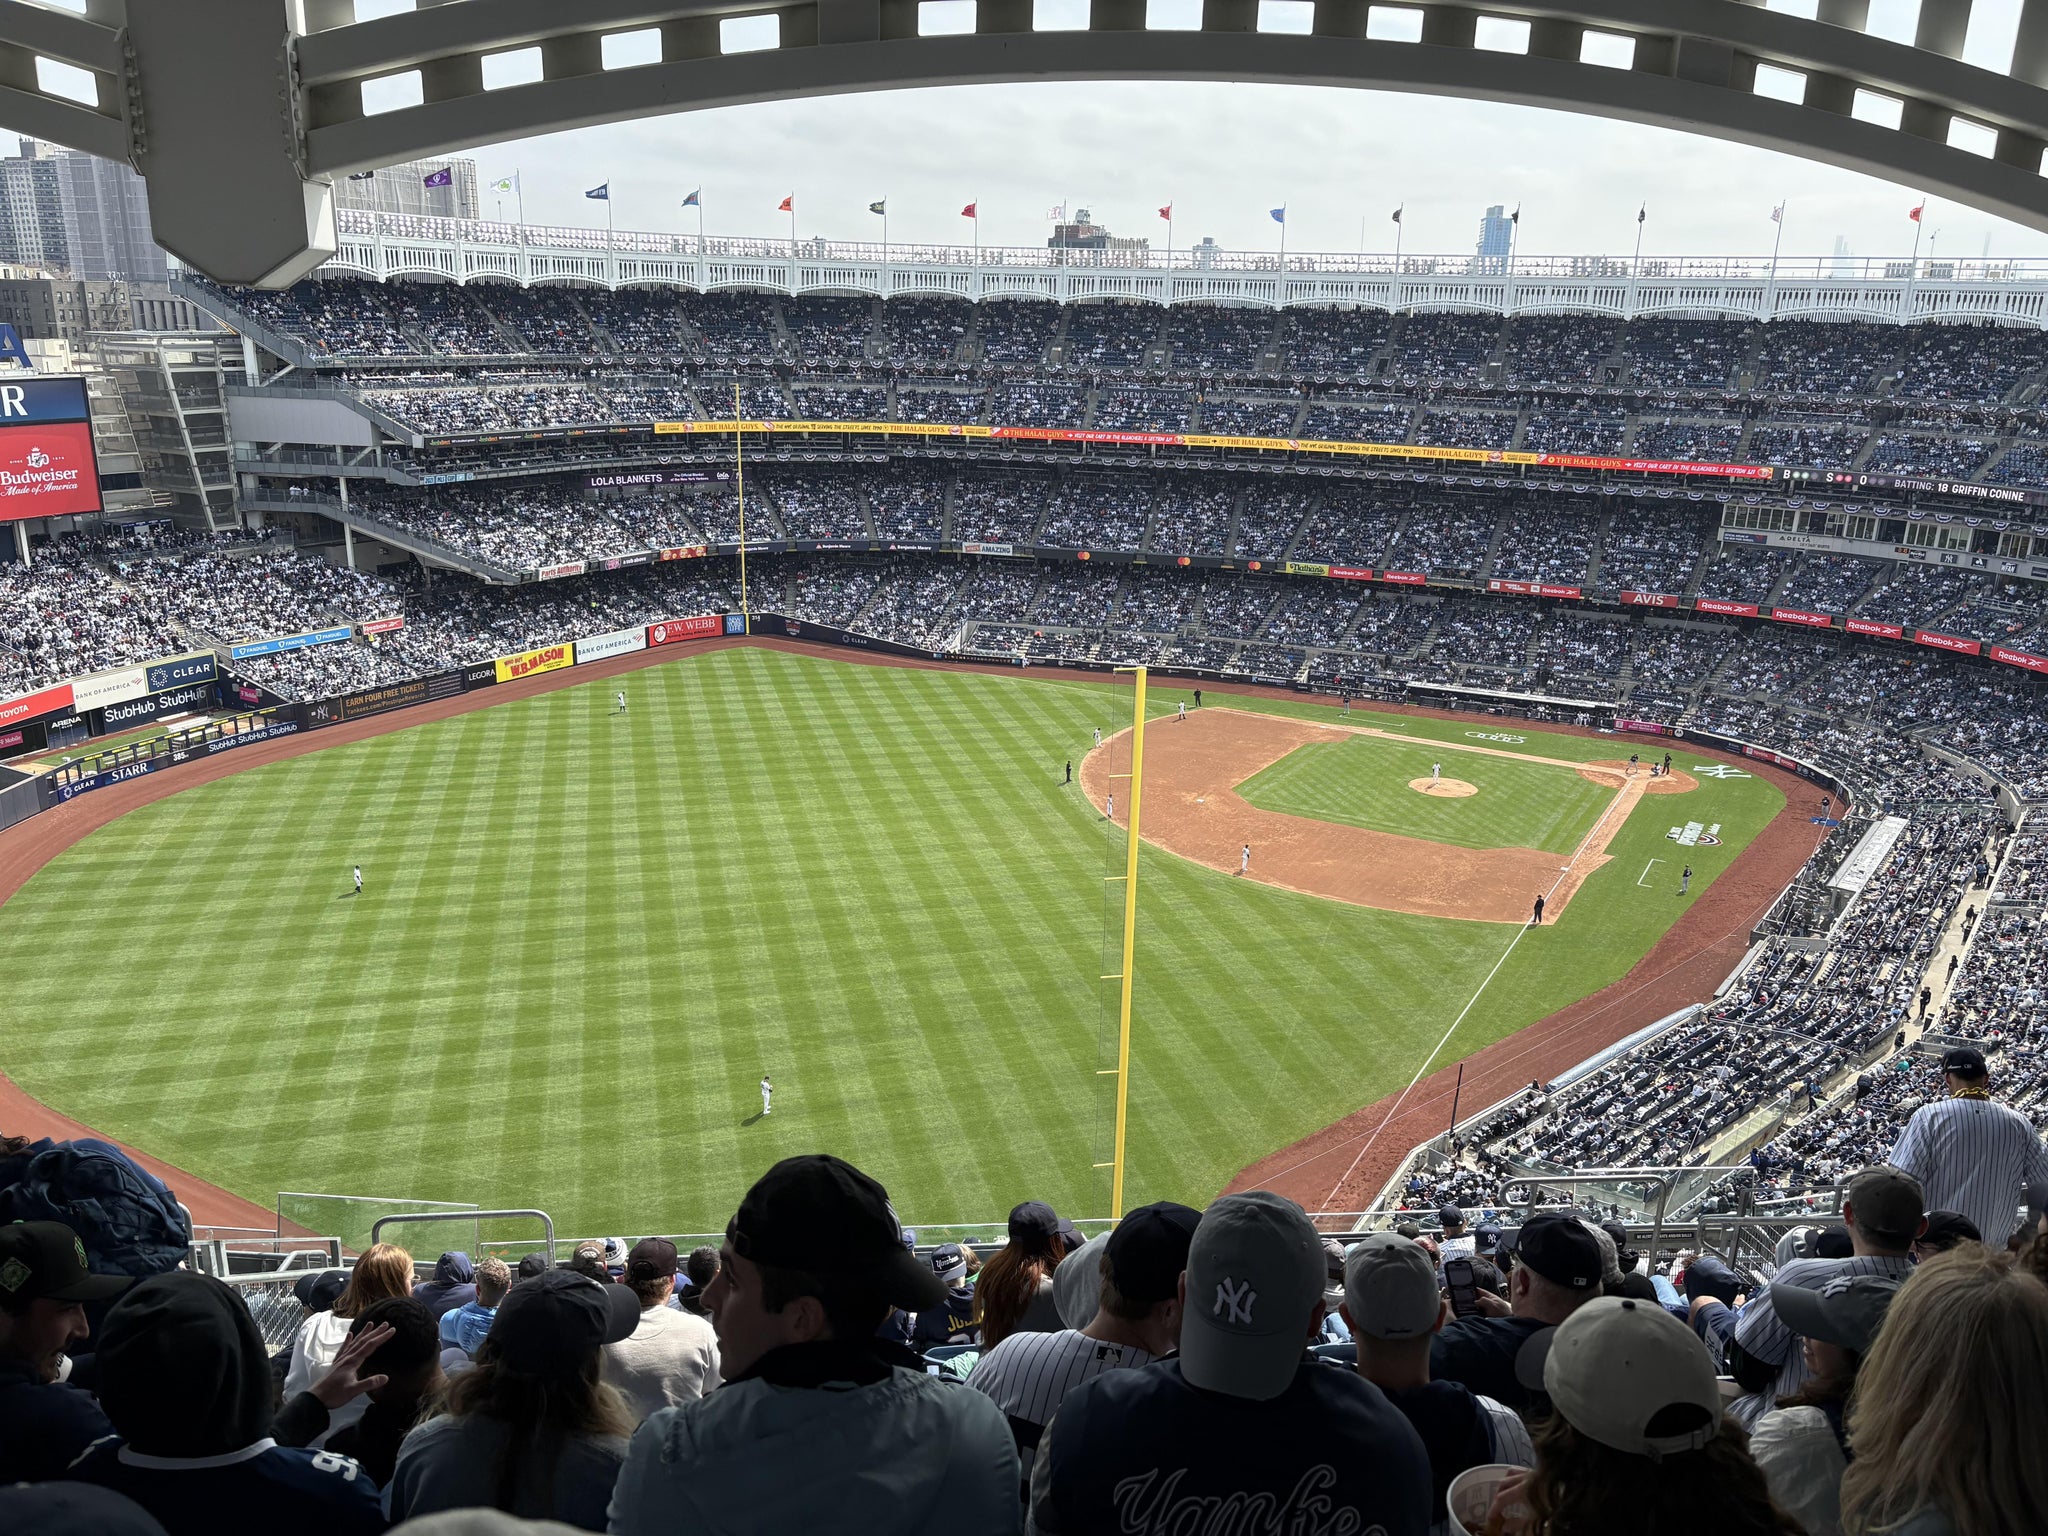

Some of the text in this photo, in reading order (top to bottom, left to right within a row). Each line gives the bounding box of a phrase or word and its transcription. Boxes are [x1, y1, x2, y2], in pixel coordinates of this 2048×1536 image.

[1009, 386, 1075, 396] ASPEN VODKA
[0, 385, 29, 416] R
[1242, 438, 1264, 446] HALAL
[1438, 450, 1462, 458] HALAL
[1464, 451, 1483, 459] GUYS
[1573, 457, 1599, 466] HALAL
[1601, 459, 1622, 467] GUYS
[0, 468, 78, 486] Budweiser
[591, 474, 663, 487] LOLA BLANKETS
[1783, 469, 1791, 479] B
[1826, 472, 1834, 482] S
[0, 482, 78, 497] Made of America
[1894, 479, 2025, 501] BATTING: 18 GRIFFIN CONINE
[1786, 535, 1811, 543] DELTA
[557, 563, 583, 575] Authority
[1334, 569, 1354, 577] Reebok
[1543, 588, 1565, 596] Reebok
[1633, 593, 1664, 605] AVIS
[1701, 602, 1732, 611] Reebok
[1776, 611, 1808, 621] Reebok
[667, 622, 684, 634] F.W.
[686, 618, 715, 629] WEBB
[1849, 622, 1880, 633] Reebok
[1922, 634, 1953, 647] Reebok
[578, 639, 632, 656] BANK OF AMERICA
[1998, 650, 2027, 664] Reebok
[173, 663, 211, 679] CLEAR
[468, 669, 496, 681] LEGORA
[75, 682, 131, 701] BANK OF AMERICA
[346, 696, 364, 707] EARN
[365, 692, 382, 703] FOUR
[383, 688, 399, 698] FREE
[400, 682, 425, 694] TICKETS
[160, 689, 206, 709] StubHub
[0, 704, 29, 719] TOYOTA
[104, 700, 156, 722] StubHub
[51, 716, 81, 728] ARENA
[270, 724, 297, 736] StubHub
[238, 731, 267, 744] StubHub
[209, 738, 236, 752] StubHub
[111, 762, 148, 781] STARR
[74, 779, 95, 792] CLEAR
[1487, 1233, 1497, 1244] NY
[1823, 1276, 1854, 1298] NY
[1213, 1274, 1257, 1324] NY
